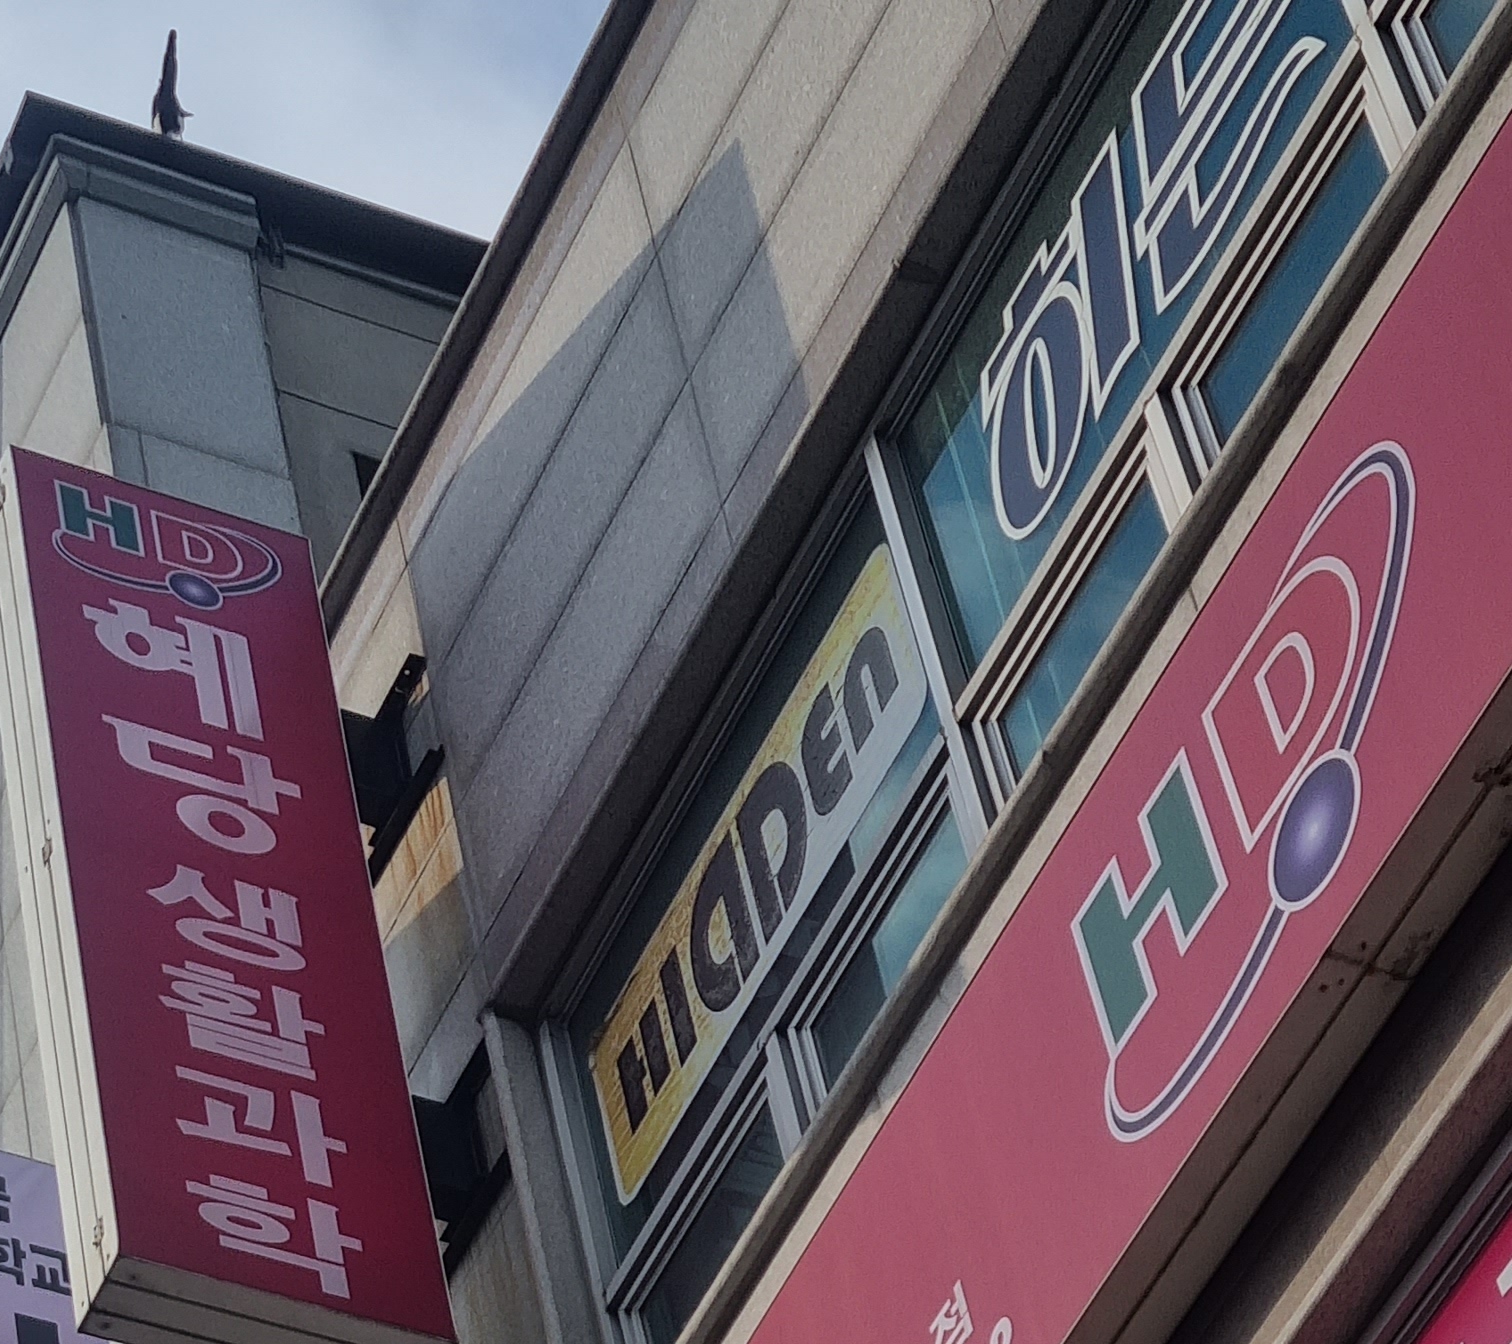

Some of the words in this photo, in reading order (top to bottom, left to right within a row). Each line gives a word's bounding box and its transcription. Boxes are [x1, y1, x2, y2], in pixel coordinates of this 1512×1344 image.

[54, 479, 244, 581] HD
[81, 597, 365, 1301] 혜당생활과학
[1070, 555, 1361, 1060] HD
